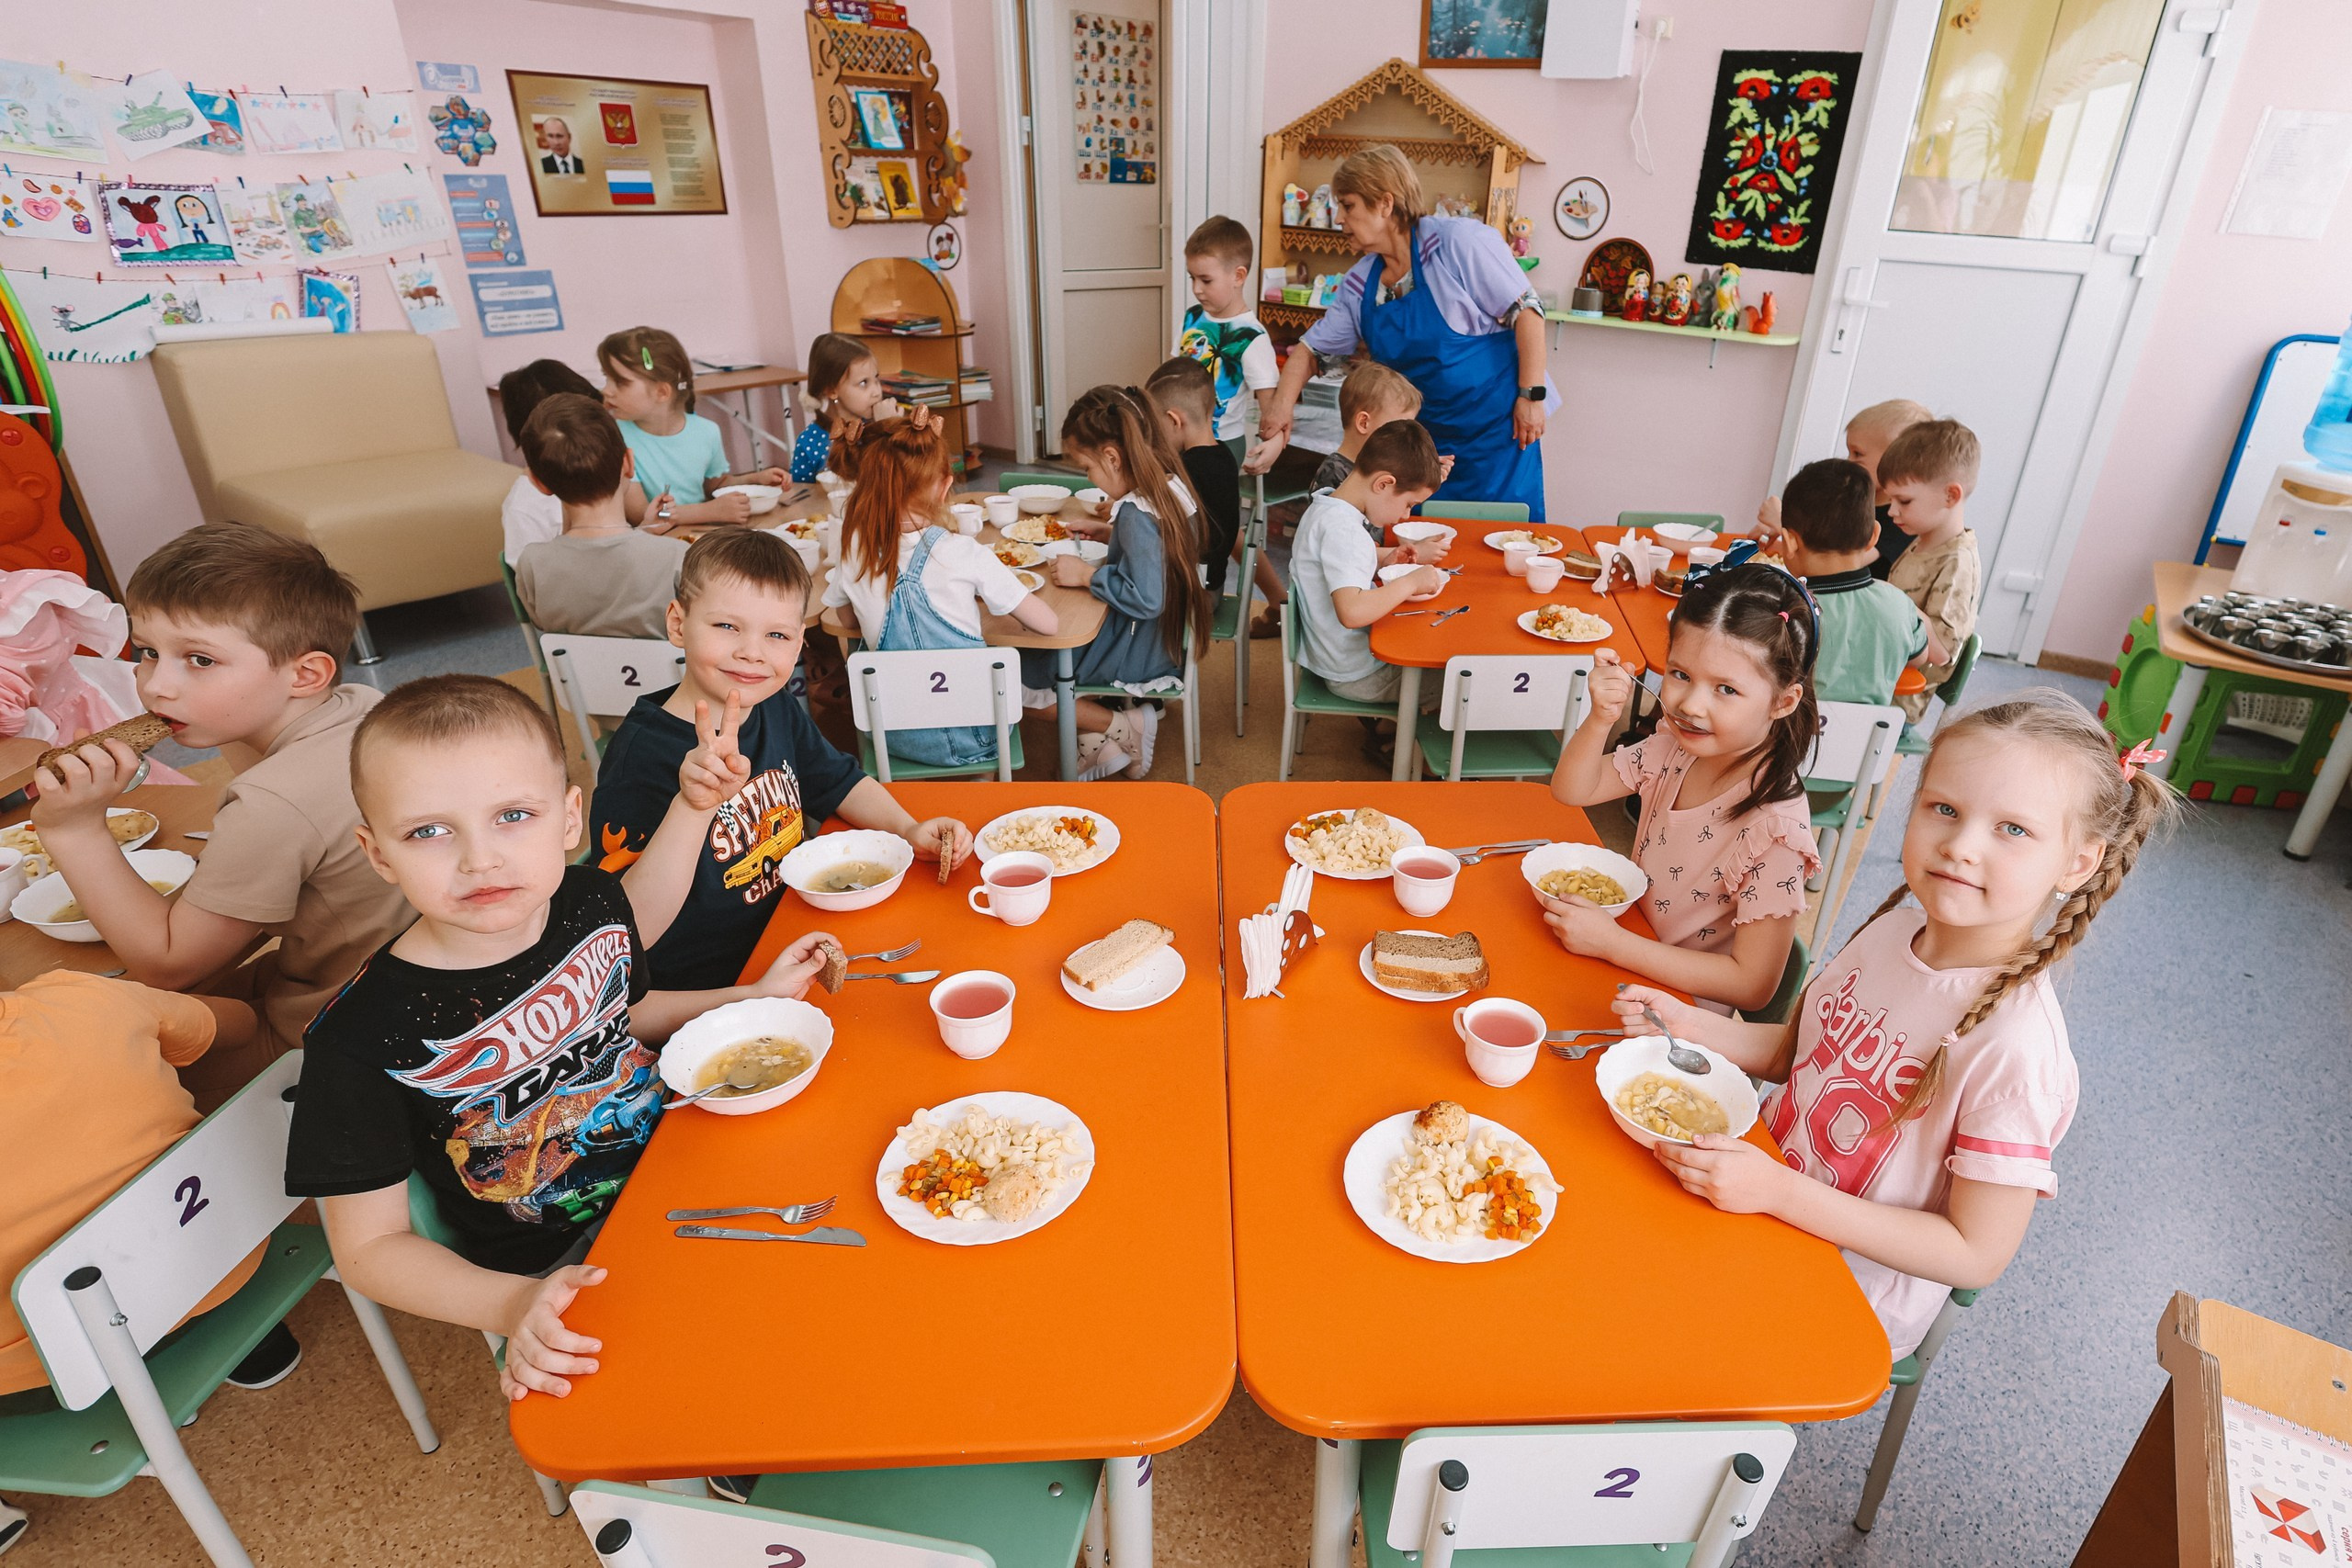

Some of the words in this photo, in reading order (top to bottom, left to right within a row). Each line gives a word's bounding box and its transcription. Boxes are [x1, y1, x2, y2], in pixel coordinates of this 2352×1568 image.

[620, 665, 641, 687] 2
[790, 676, 807, 697] 2
[930, 671, 949, 693] 2
[1513, 672, 1531, 694] 2
[476, 989, 571, 1073] HOT
[1816, 967, 1932, 1109] Barbie
[174, 1175, 210, 1228] 2
[1593, 1467, 1641, 1498] 2
